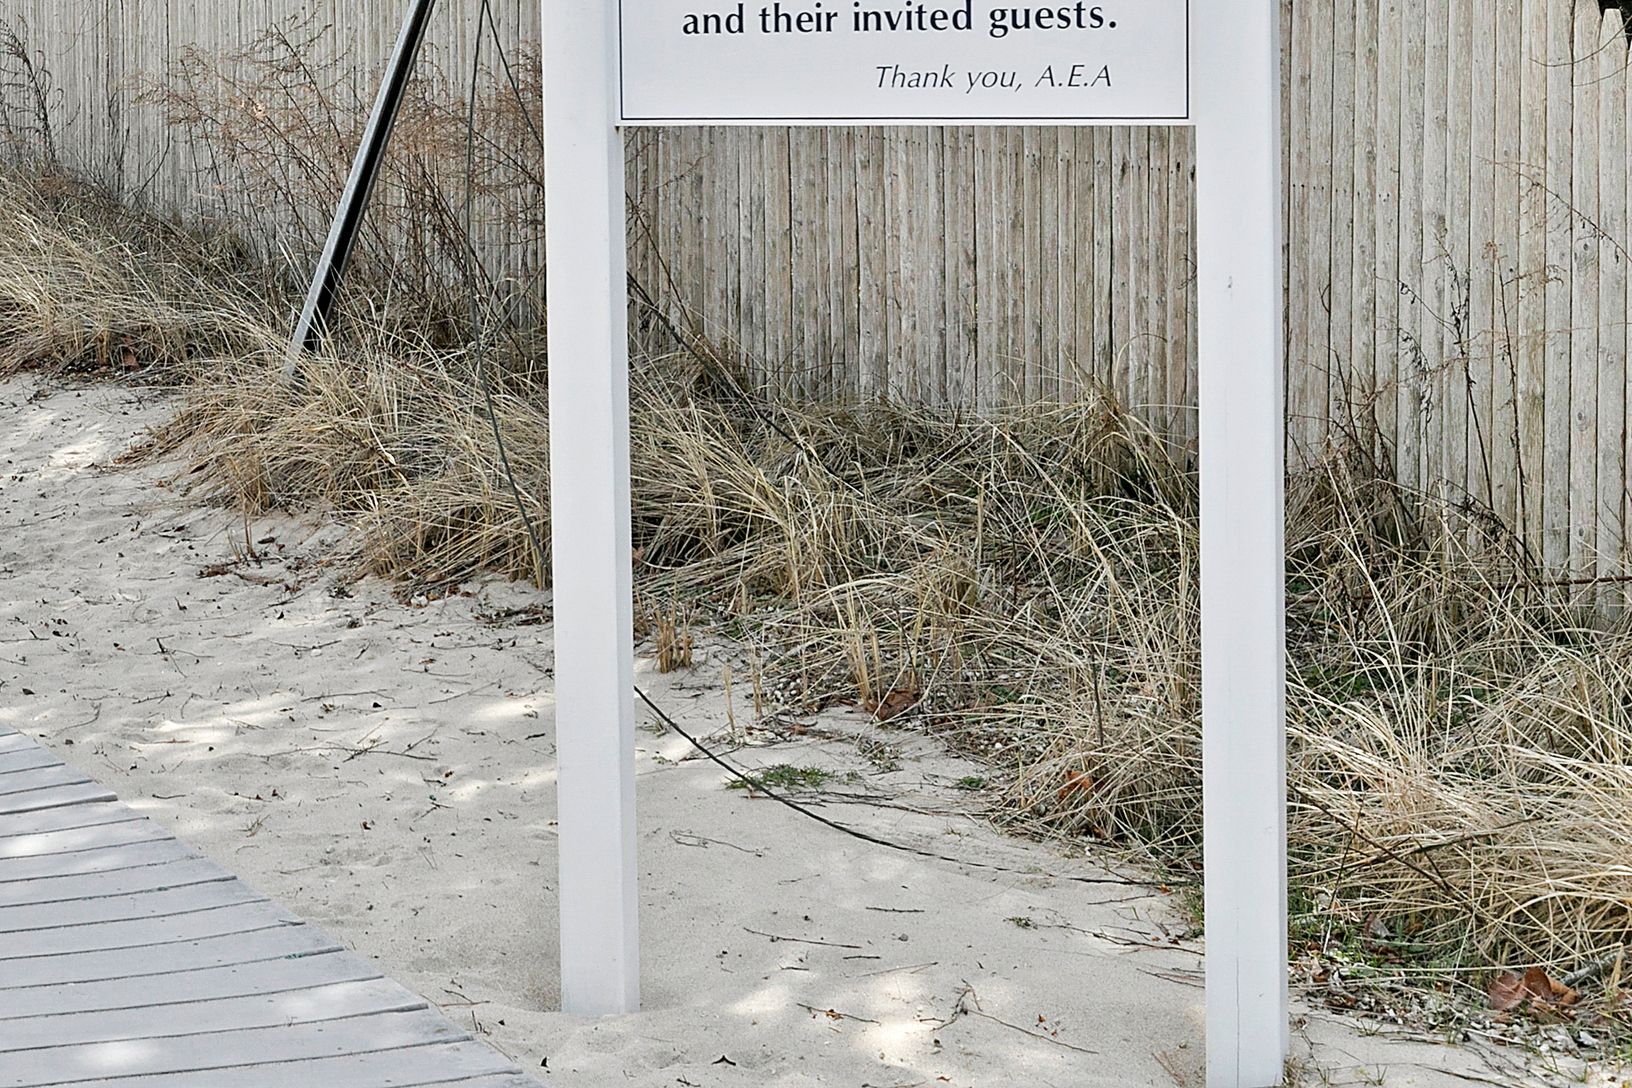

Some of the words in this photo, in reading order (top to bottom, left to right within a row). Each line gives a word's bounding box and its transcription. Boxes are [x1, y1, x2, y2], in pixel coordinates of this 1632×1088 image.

[682, 2, 745, 35] and
[758, 1, 839, 34] their
[989, 0, 1117, 39] guests.
[875, 63, 956, 89] Thank
[965, 71, 1022, 95] you,
[1034, 64, 1112, 88] A.E.A
